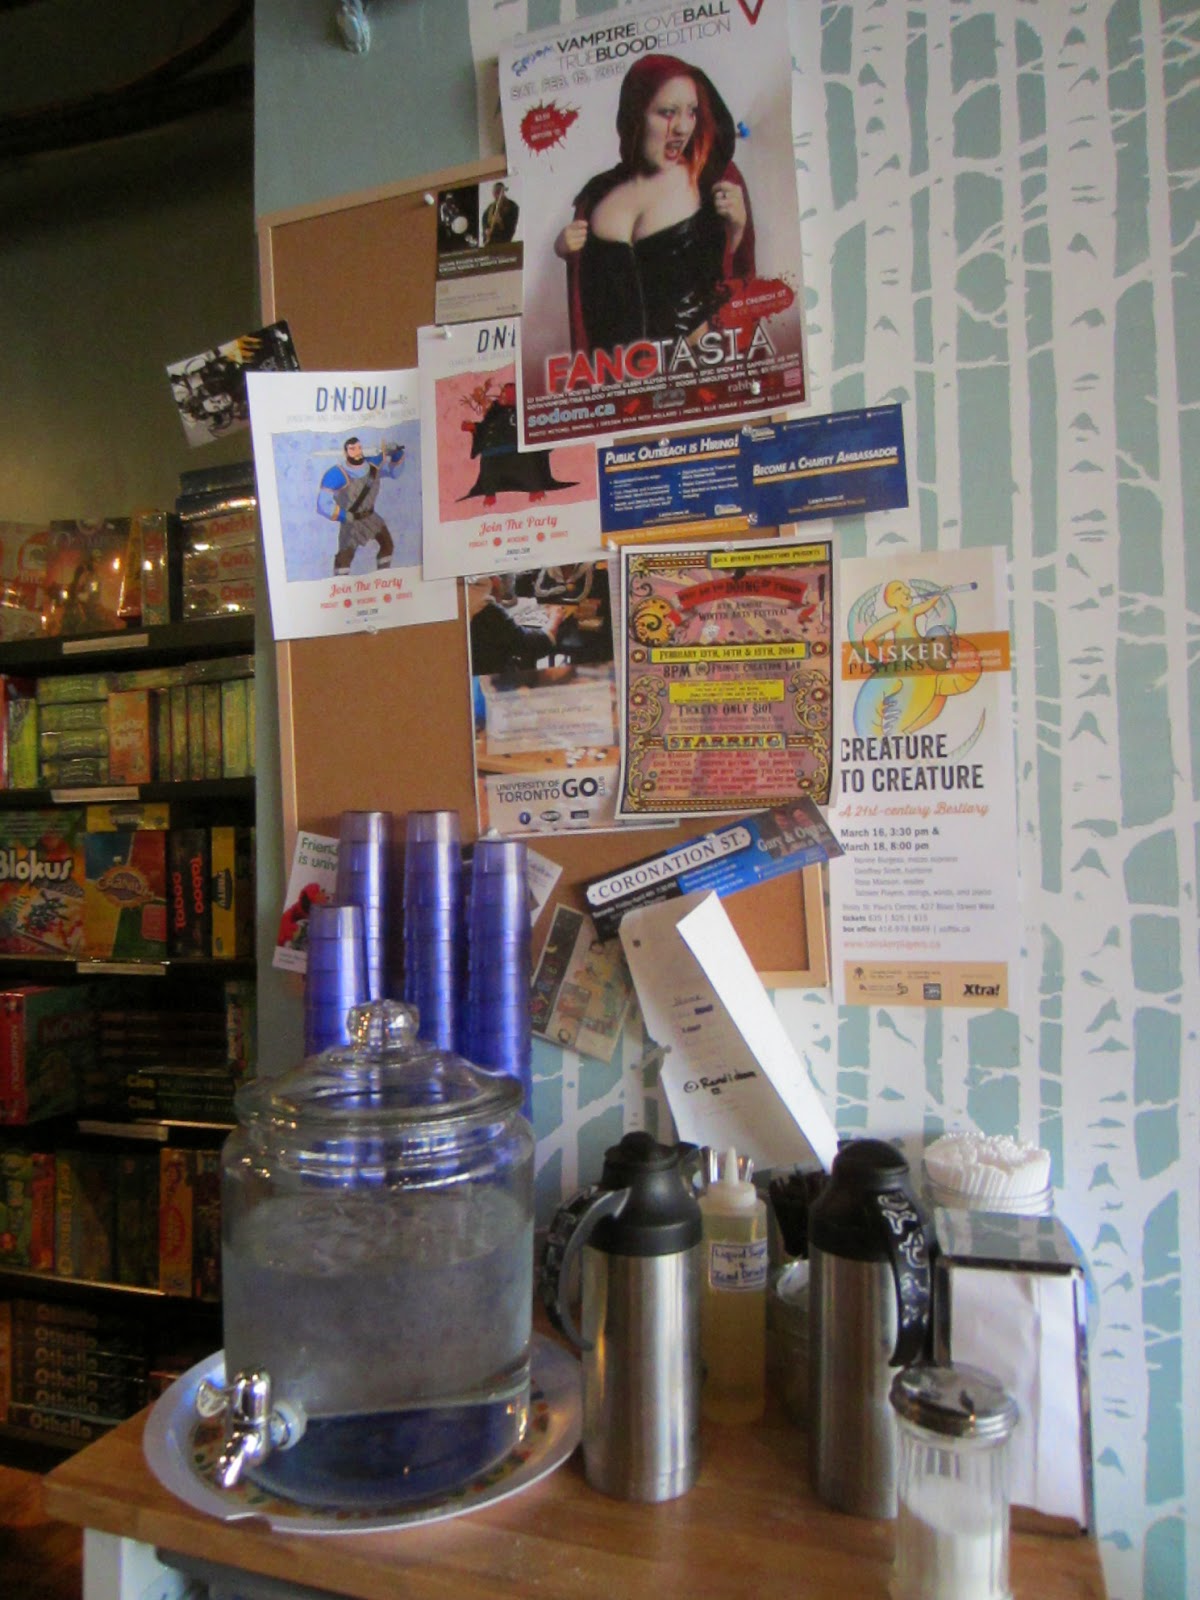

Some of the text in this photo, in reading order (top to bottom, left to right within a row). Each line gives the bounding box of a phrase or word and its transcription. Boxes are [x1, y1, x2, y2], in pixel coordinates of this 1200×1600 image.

[527, 403, 616, 428] sodom.ca
[752, 462, 787, 477] BECOME
[798, 454, 833, 470] CHARITY
[836, 446, 898, 464] AMBASSADOR
[478, 515, 558, 537] Join The Party
[329, 577, 403, 599] Join The Party
[842, 642, 948, 665] ALISKER
[663, 664, 690, 678] 8PM
[669, 736, 781, 749] STARRING
[841, 734, 948, 762] CREATURE
[496, 776, 599, 799] UNIVERSITY OF GO
[841, 764, 984, 793] TO CREATURE
[497, 788, 560, 803] TORONTO
[839, 805, 853, 818] A
[934, 801, 990, 818] Bestiary
[840, 828, 869, 838] March
[890, 827, 912, 837] 3:30
[914, 829, 929, 838] pm
[931, 826, 940, 836] &
[840, 842, 869, 852] March
[891, 842, 912, 851] 8:00
[915, 843, 930, 852] pm
[298, 852, 308, 865] is
[598, 842, 716, 900] CORONATION
[963, 982, 1001, 997] Xtra!
